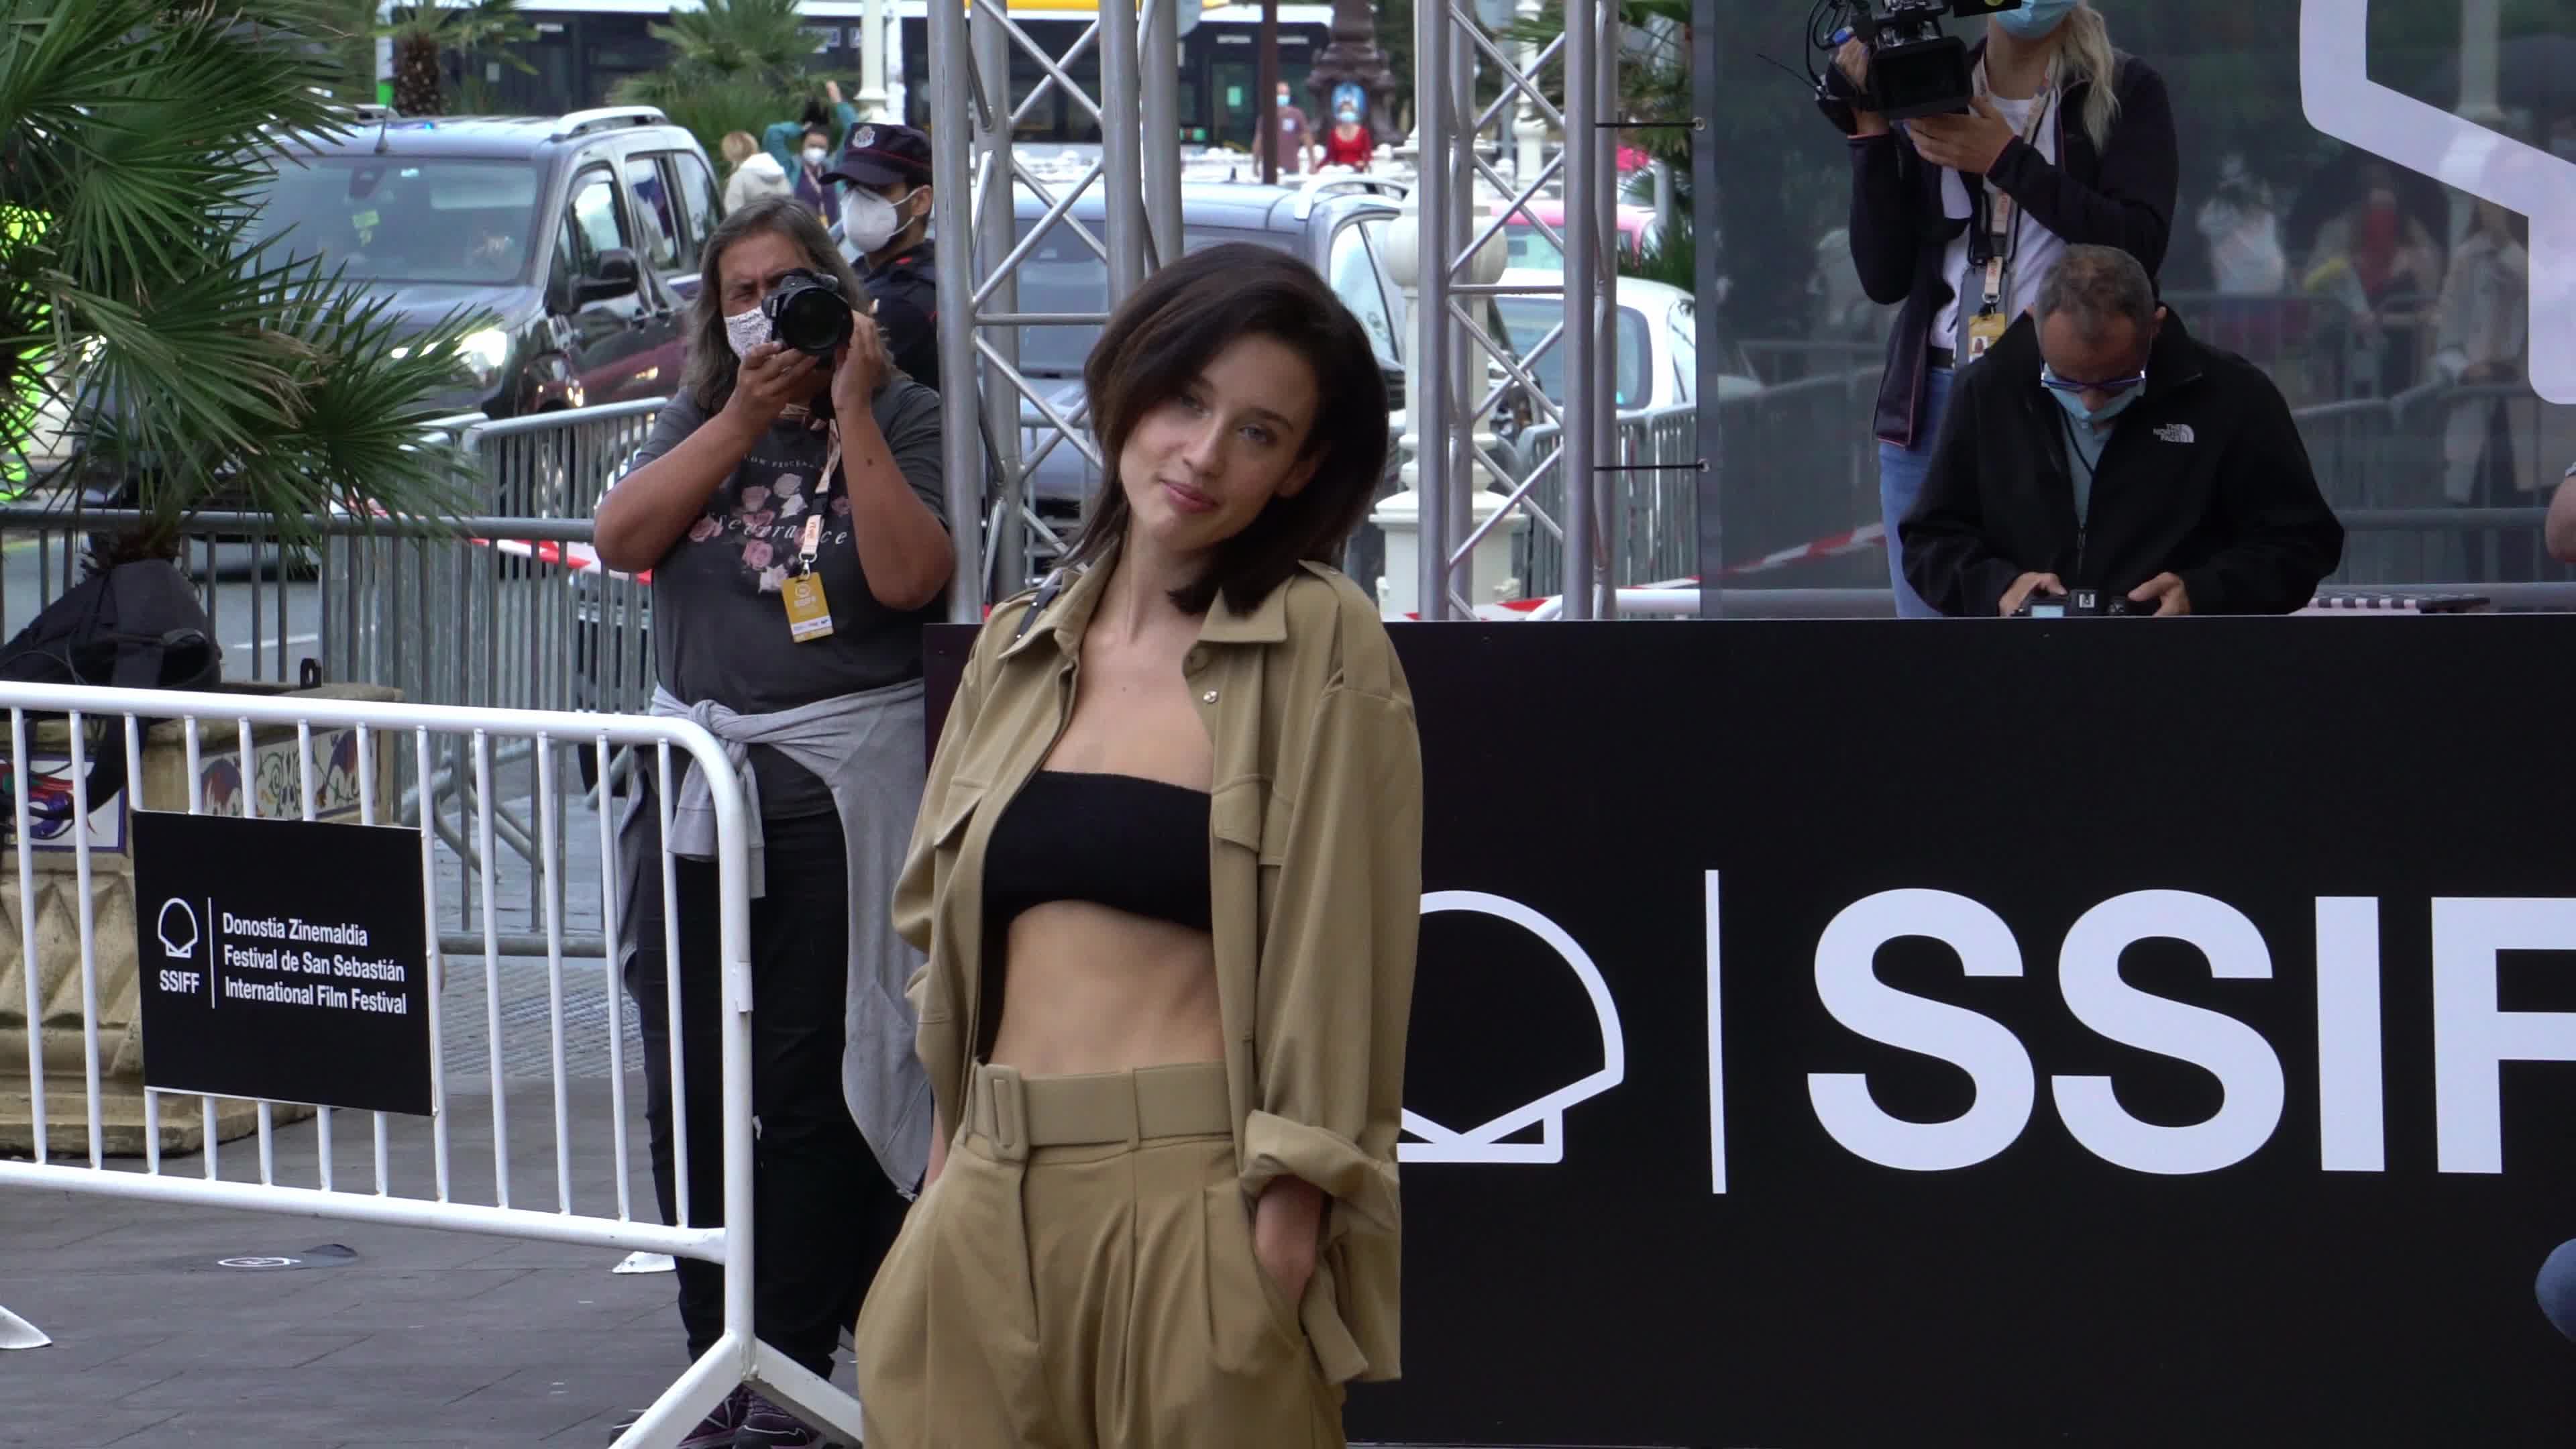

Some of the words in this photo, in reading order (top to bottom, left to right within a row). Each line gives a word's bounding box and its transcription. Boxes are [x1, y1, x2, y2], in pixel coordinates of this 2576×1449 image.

[223, 912, 285, 938] Donostia
[289, 918, 367, 946] Zinemaldia
[224, 945, 277, 969] Festival
[281, 950, 299, 971] de
[303, 952, 330, 975] San
[334, 955, 405, 981] Sebastián
[160, 969, 199, 993] SSIFF
[225, 976, 313, 1005] International
[317, 985, 347, 1008] Film
[352, 988, 407, 1014] Festival
